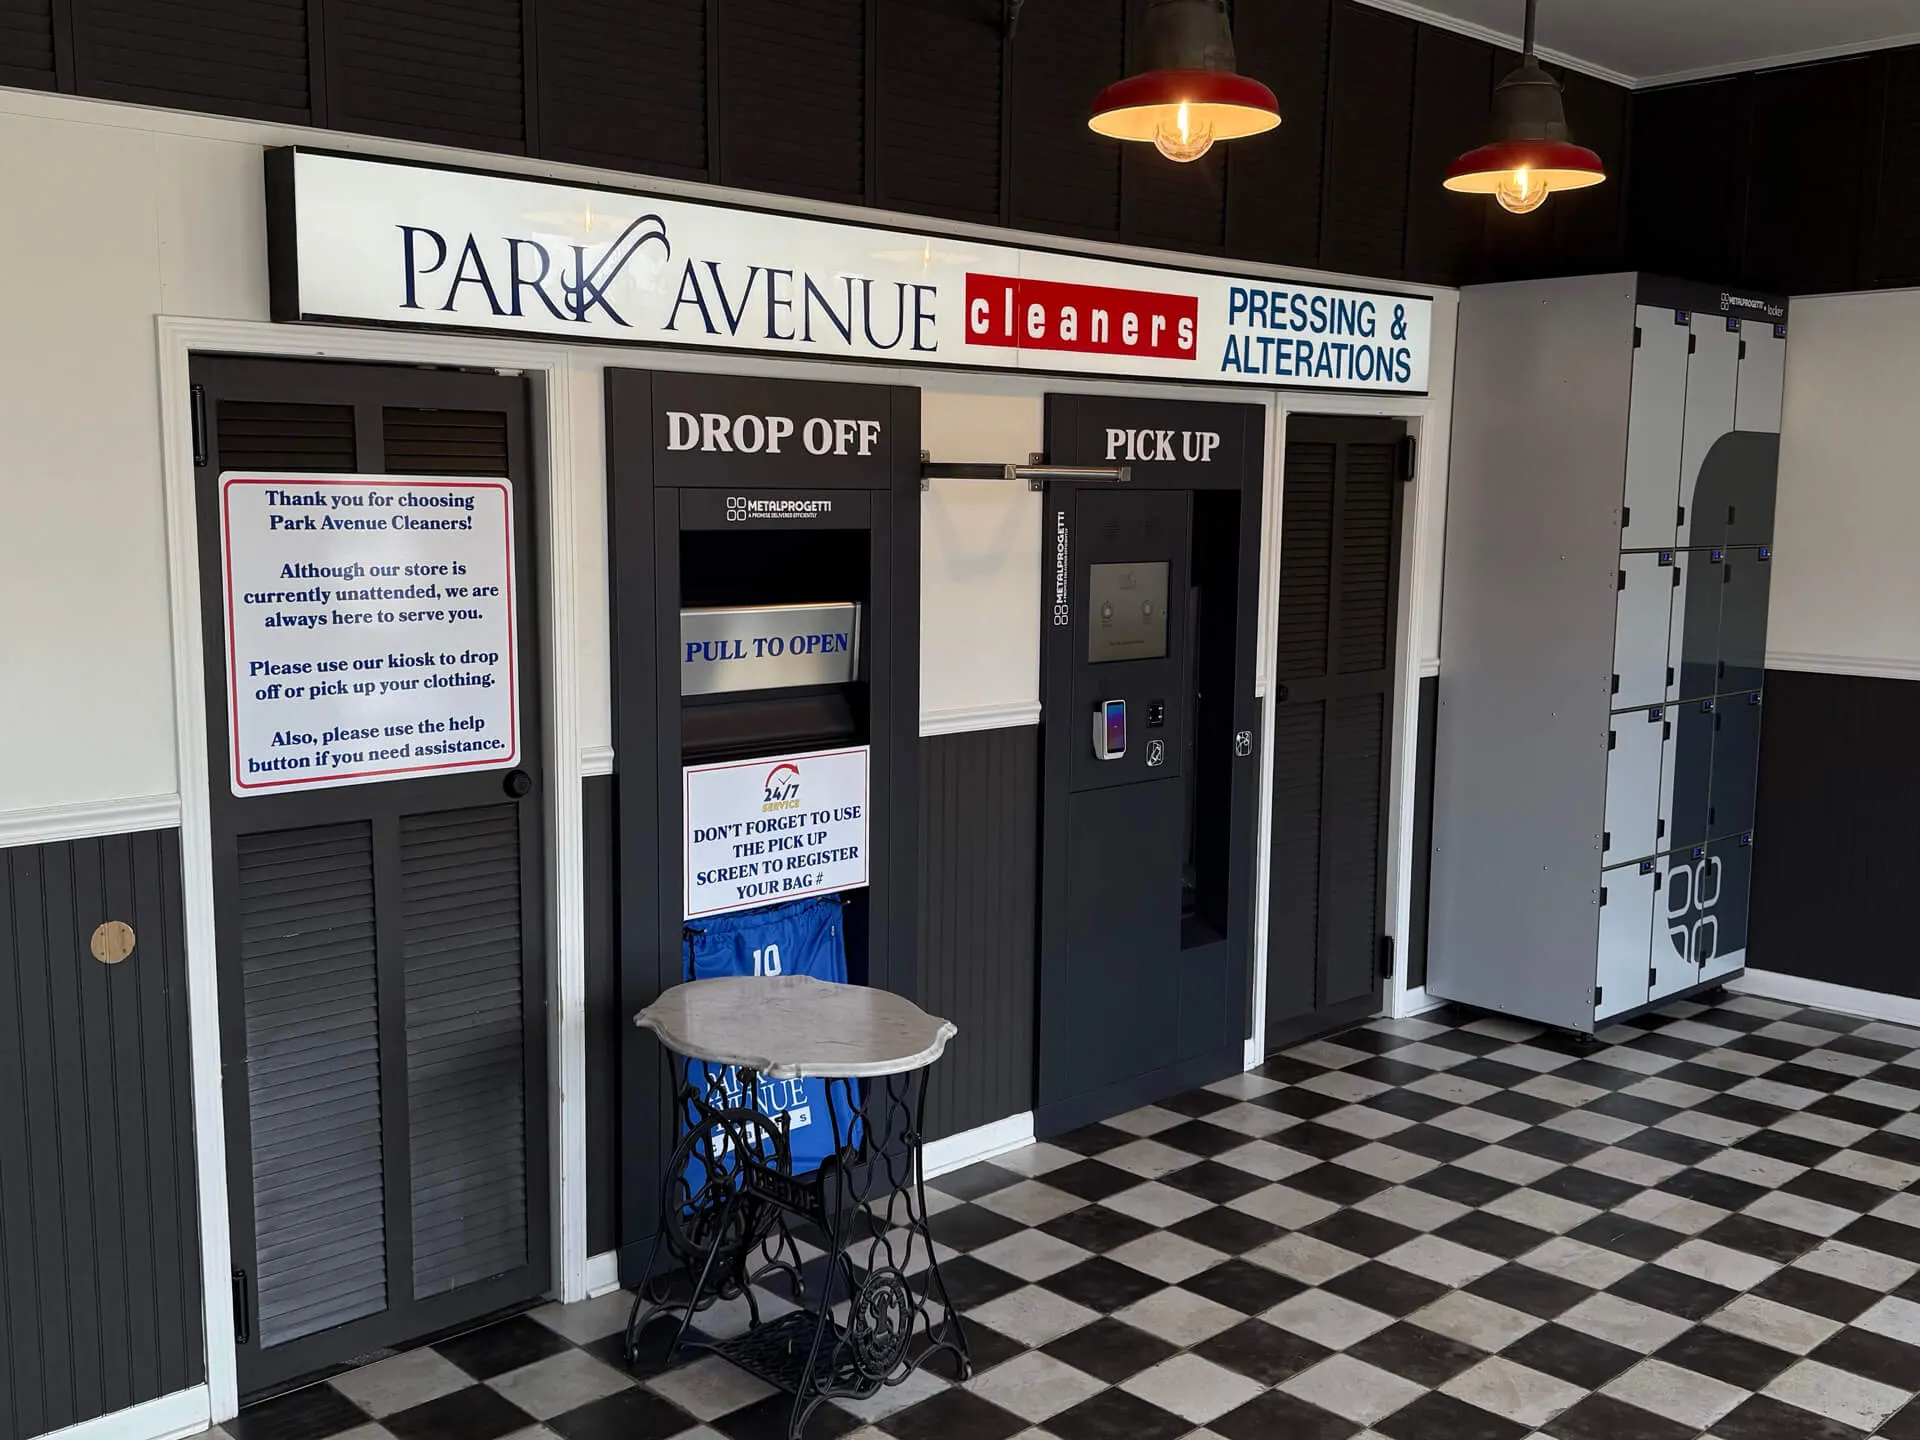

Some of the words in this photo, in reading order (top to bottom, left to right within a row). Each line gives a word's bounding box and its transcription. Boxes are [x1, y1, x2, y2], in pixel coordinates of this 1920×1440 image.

[395, 213, 671, 327] PARK
[664, 257, 938, 352] AVENUE
[970, 287, 1194, 350] cleaners
[1229, 286, 1377, 338] PRESSING
[1390, 303, 1408, 341] &
[1221, 334, 1411, 383] ALTERATIONS
[666, 411, 794, 453] DROP
[802, 417, 881, 456] OFF
[1105, 428, 1176, 461] PICK
[1182, 431, 1220, 462] UP
[265, 490, 327, 507] Thank
[332, 494, 364, 510] you
[368, 492, 394, 506] for
[398, 493, 475, 510] choosing
[747, 500, 832, 512] METALPROGETTI
[270, 515, 316, 530] Park
[321, 516, 387, 530] Avenue
[392, 516, 473, 530] Cleaners!
[280, 562, 364, 580] Although
[370, 565, 400, 577] our
[405, 563, 449, 577] store
[452, 561, 467, 576] is
[1056, 511, 1065, 604] METALPROGETTI
[244, 587, 331, 605] currently
[336, 584, 441, 602] unattended,
[446, 586, 468, 598] we
[473, 585, 499, 597] are
[265, 613, 327, 629] always
[332, 610, 373, 624] here
[378, 611, 394, 623] to
[399, 609, 444, 622] serve
[449, 608, 483, 624] you.
[685, 638, 747, 662] PULL
[752, 637, 784, 657] TO
[790, 633, 848, 654] OPEN
[250, 659, 312, 677] Please
[317, 660, 348, 673] use
[353, 659, 384, 671] our
[388, 652, 435, 668] kiosk
[440, 653, 456, 666] to
[460, 650, 499, 669] drop
[256, 684, 282, 701] off
[285, 686, 304, 699] or
[310, 679, 348, 700] pick
[354, 683, 375, 697] up
[380, 676, 419, 695] your
[424, 672, 496, 690] clothing.
[271, 730, 318, 747] Also,
[322, 726, 380, 746] please
[384, 724, 413, 737] use
[419, 719, 445, 734] the
[449, 716, 485, 733] help
[249, 755, 310, 773] button
[315, 750, 331, 767] if
[332, 751, 364, 767] you
[368, 744, 410, 761] need
[415, 737, 505, 756] assistance.
[761, 799, 800, 812] SERVICE
[764, 784, 800, 802] 24/7
[694, 823, 742, 843] DON'T
[746, 813, 807, 835] FORGET
[810, 810, 830, 825] TO
[834, 806, 861, 821] USE
[733, 841, 764, 858] THE
[768, 835, 803, 852] PICK
[807, 831, 827, 845] UP
[696, 862, 759, 885] SCREEN
[762, 858, 783, 874] TO
[786, 846, 859, 870] REGISTER
[737, 881, 779, 899] YOUR
[783, 874, 813, 891] BAG
[816, 872, 824, 885] #
